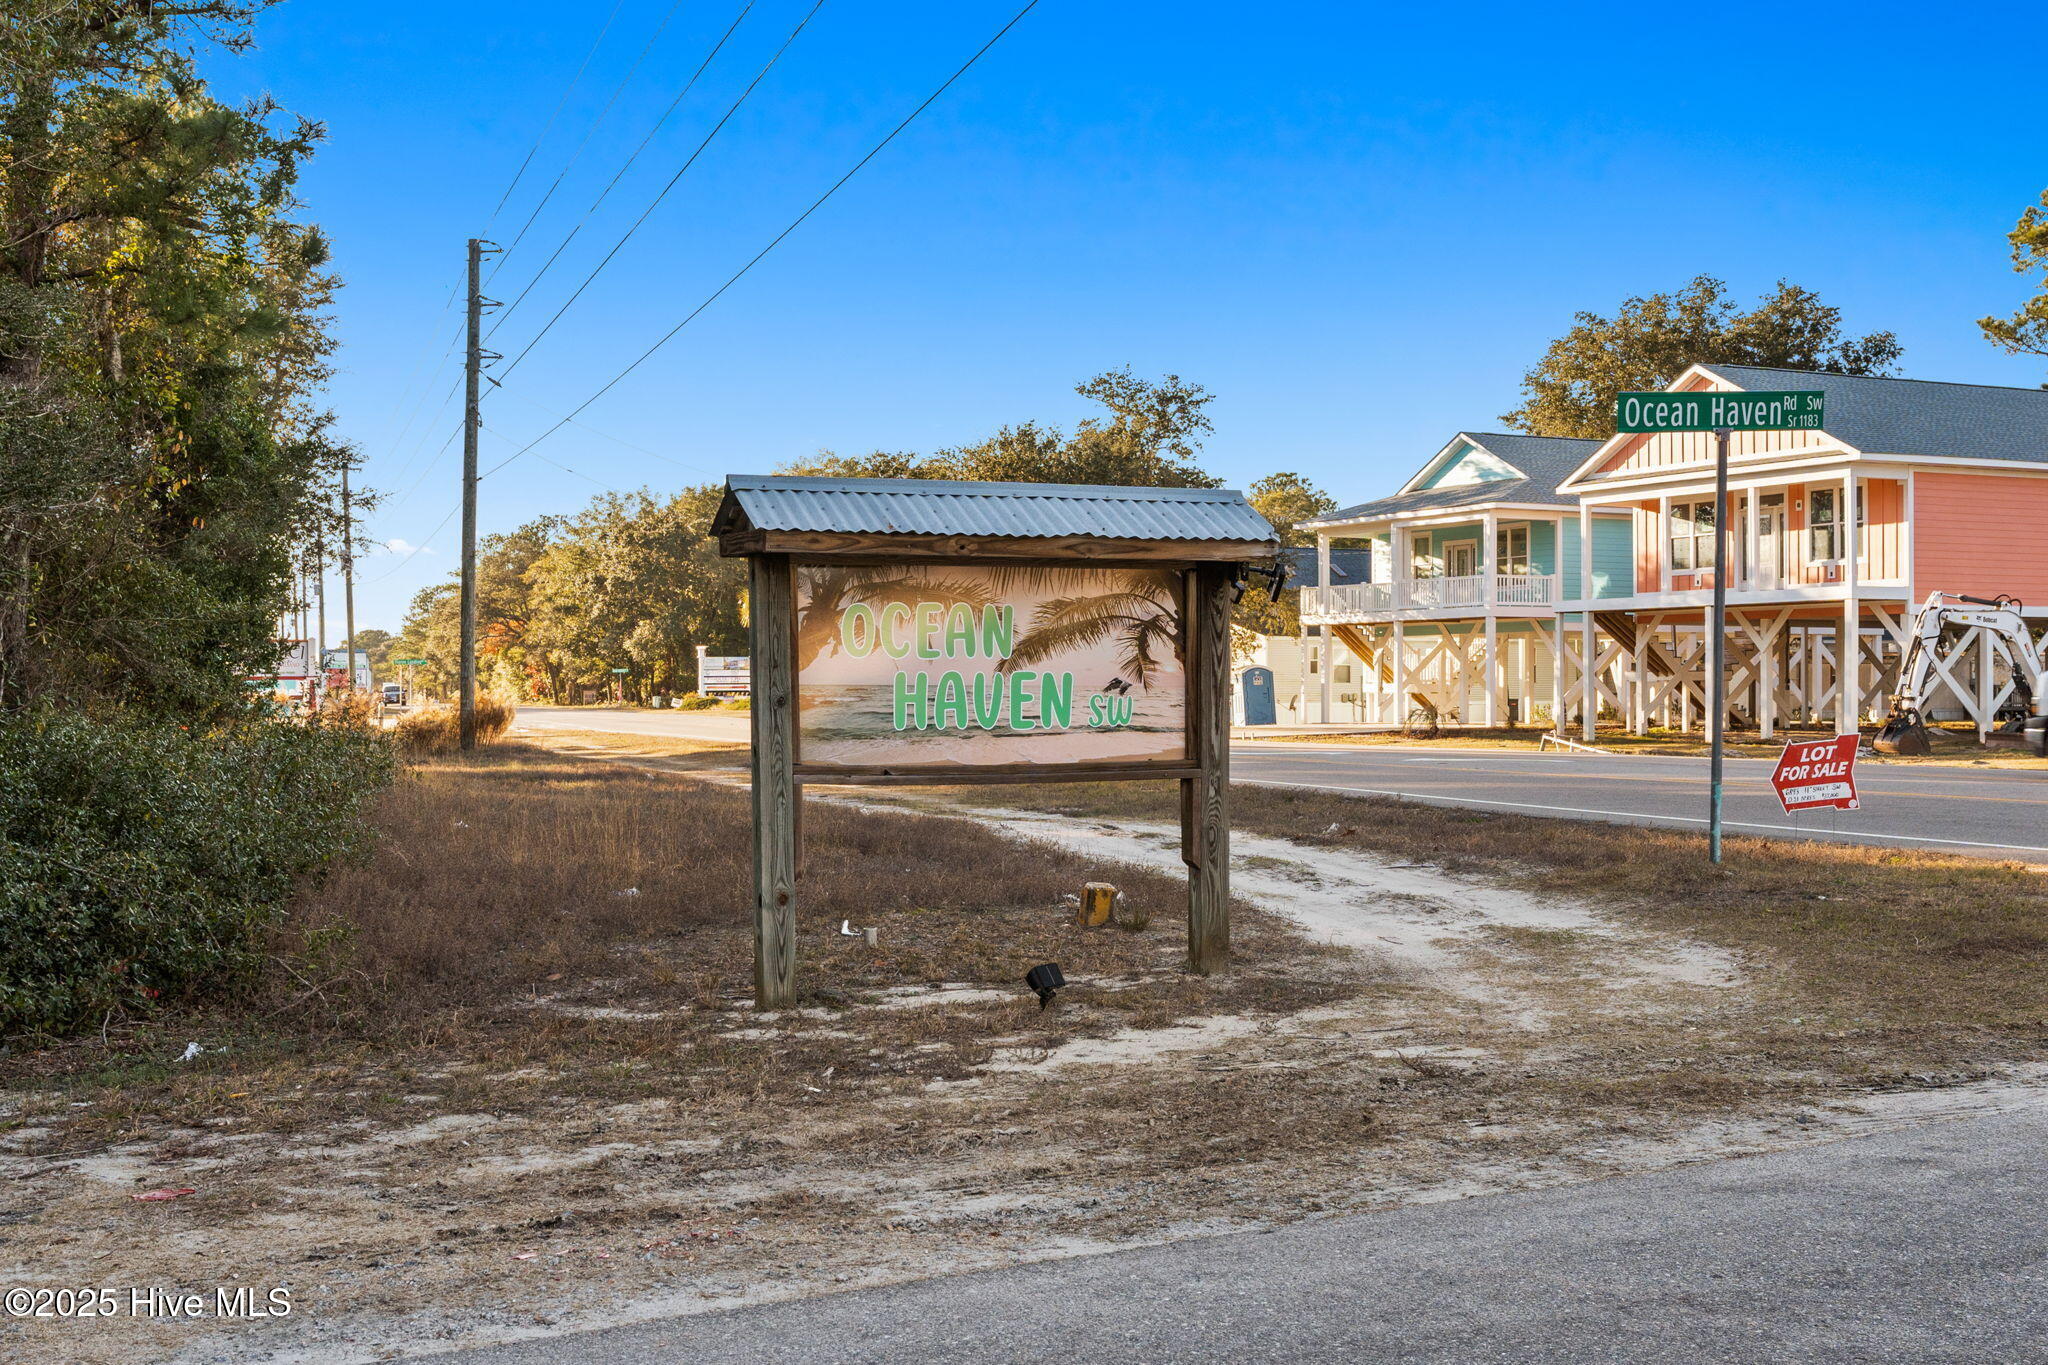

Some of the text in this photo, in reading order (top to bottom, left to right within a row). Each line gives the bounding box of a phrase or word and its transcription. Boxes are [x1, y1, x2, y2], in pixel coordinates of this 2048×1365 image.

[1625, 397, 1699, 428] Ocean
[1711, 397, 1782, 427] Haven
[1783, 395, 1797, 411] Rd
[1787, 414, 1819, 428] Sr 1183
[841, 602, 1014, 660] OCEAN
[893, 670, 1073, 731] HAVEN
[1800, 745, 1838, 763] LOT
[1779, 761, 1849, 782] FOR SALE
